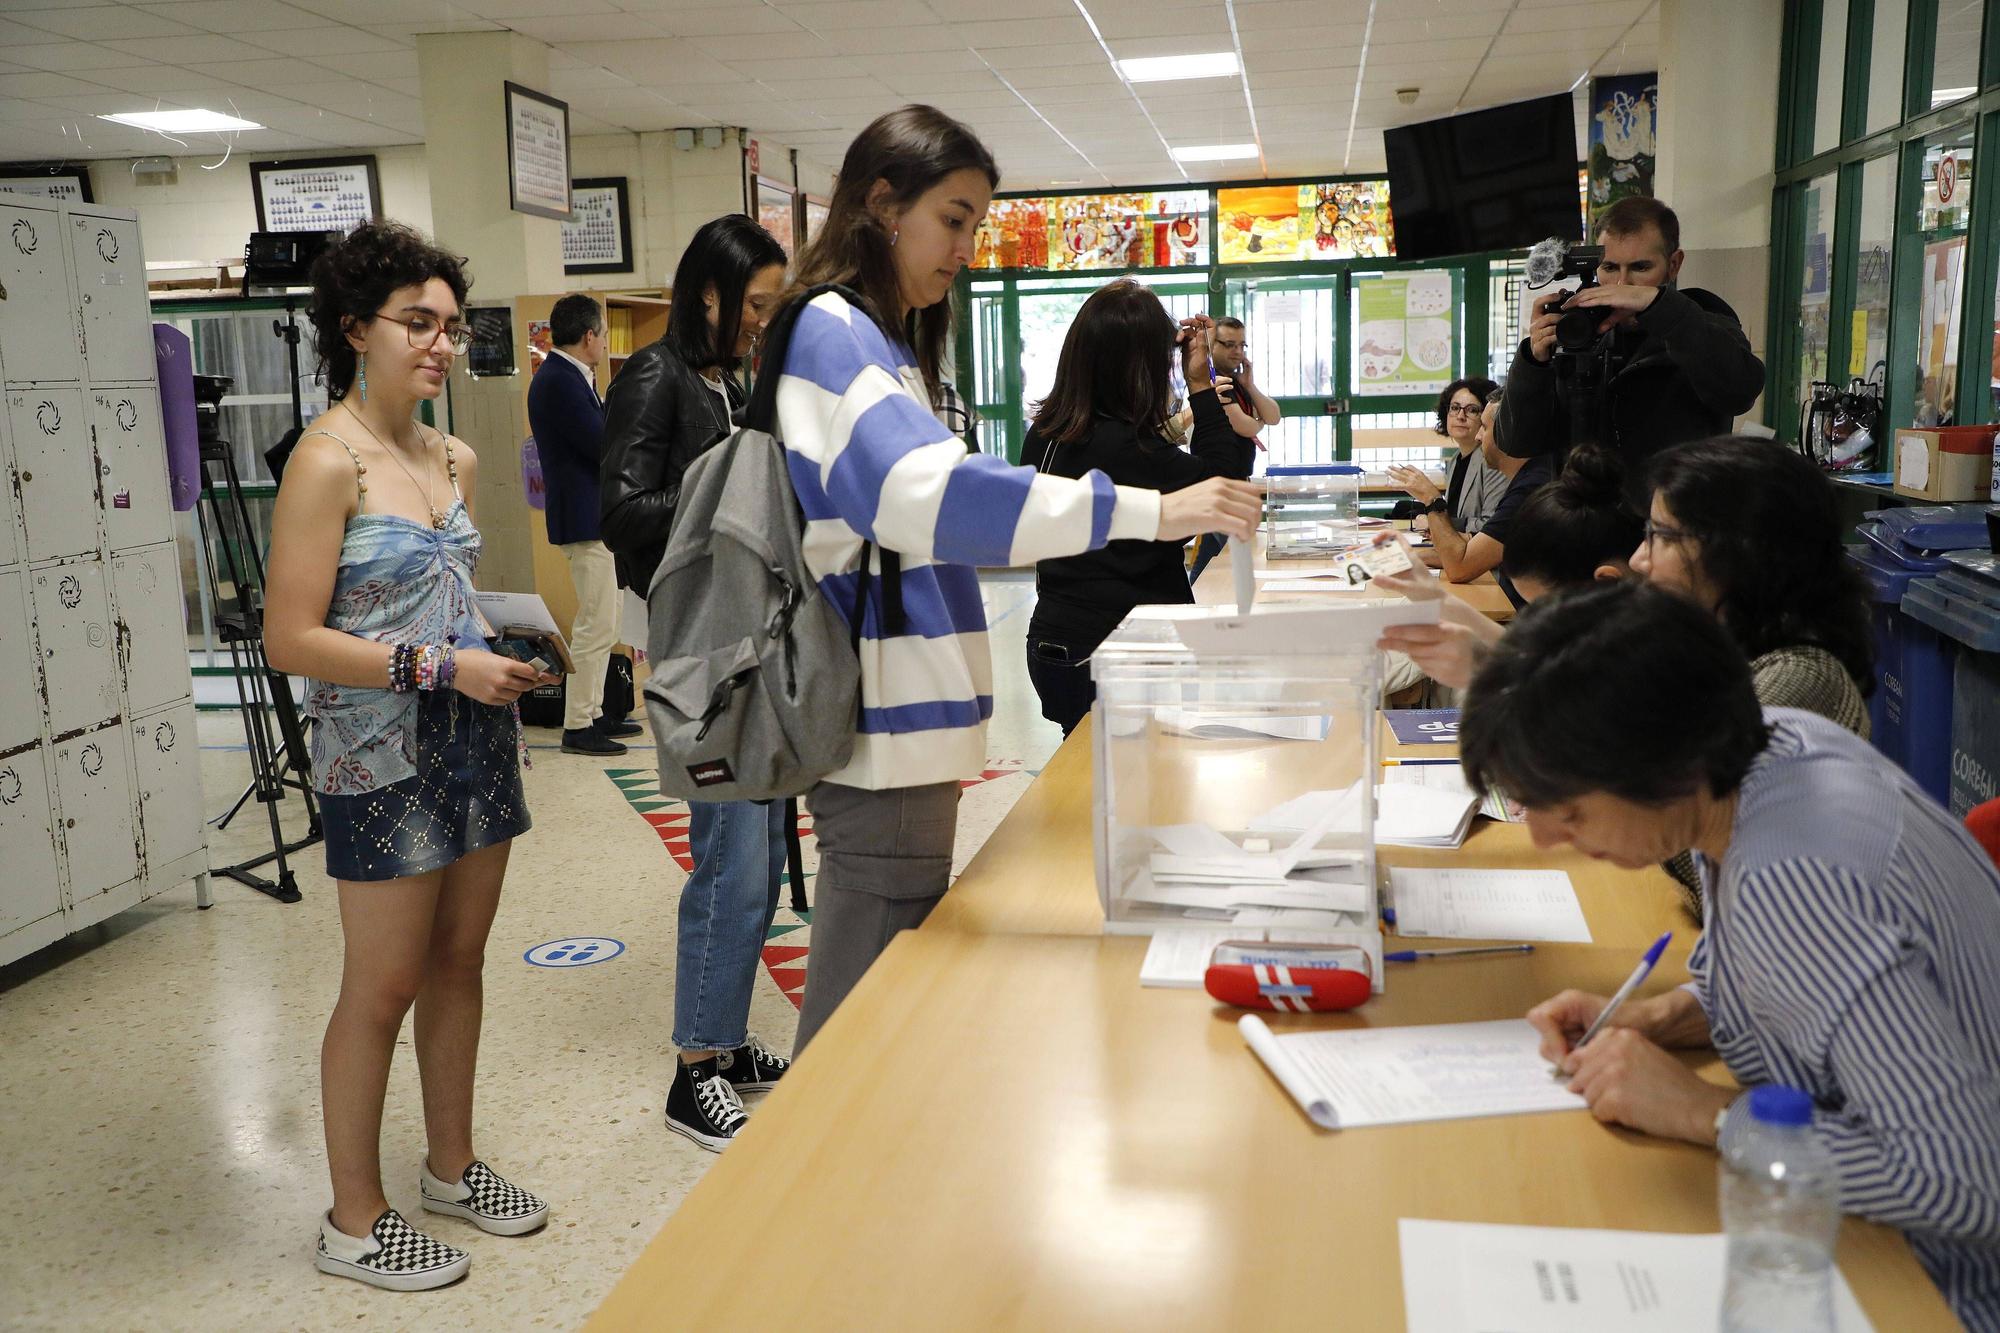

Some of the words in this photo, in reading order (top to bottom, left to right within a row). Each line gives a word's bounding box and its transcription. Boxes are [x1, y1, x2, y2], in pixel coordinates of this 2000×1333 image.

[76, 220, 87, 231] 45
[38, 576, 48, 587] 43
[136, 726, 145, 739] 48
[59, 749, 69, 761] 44
